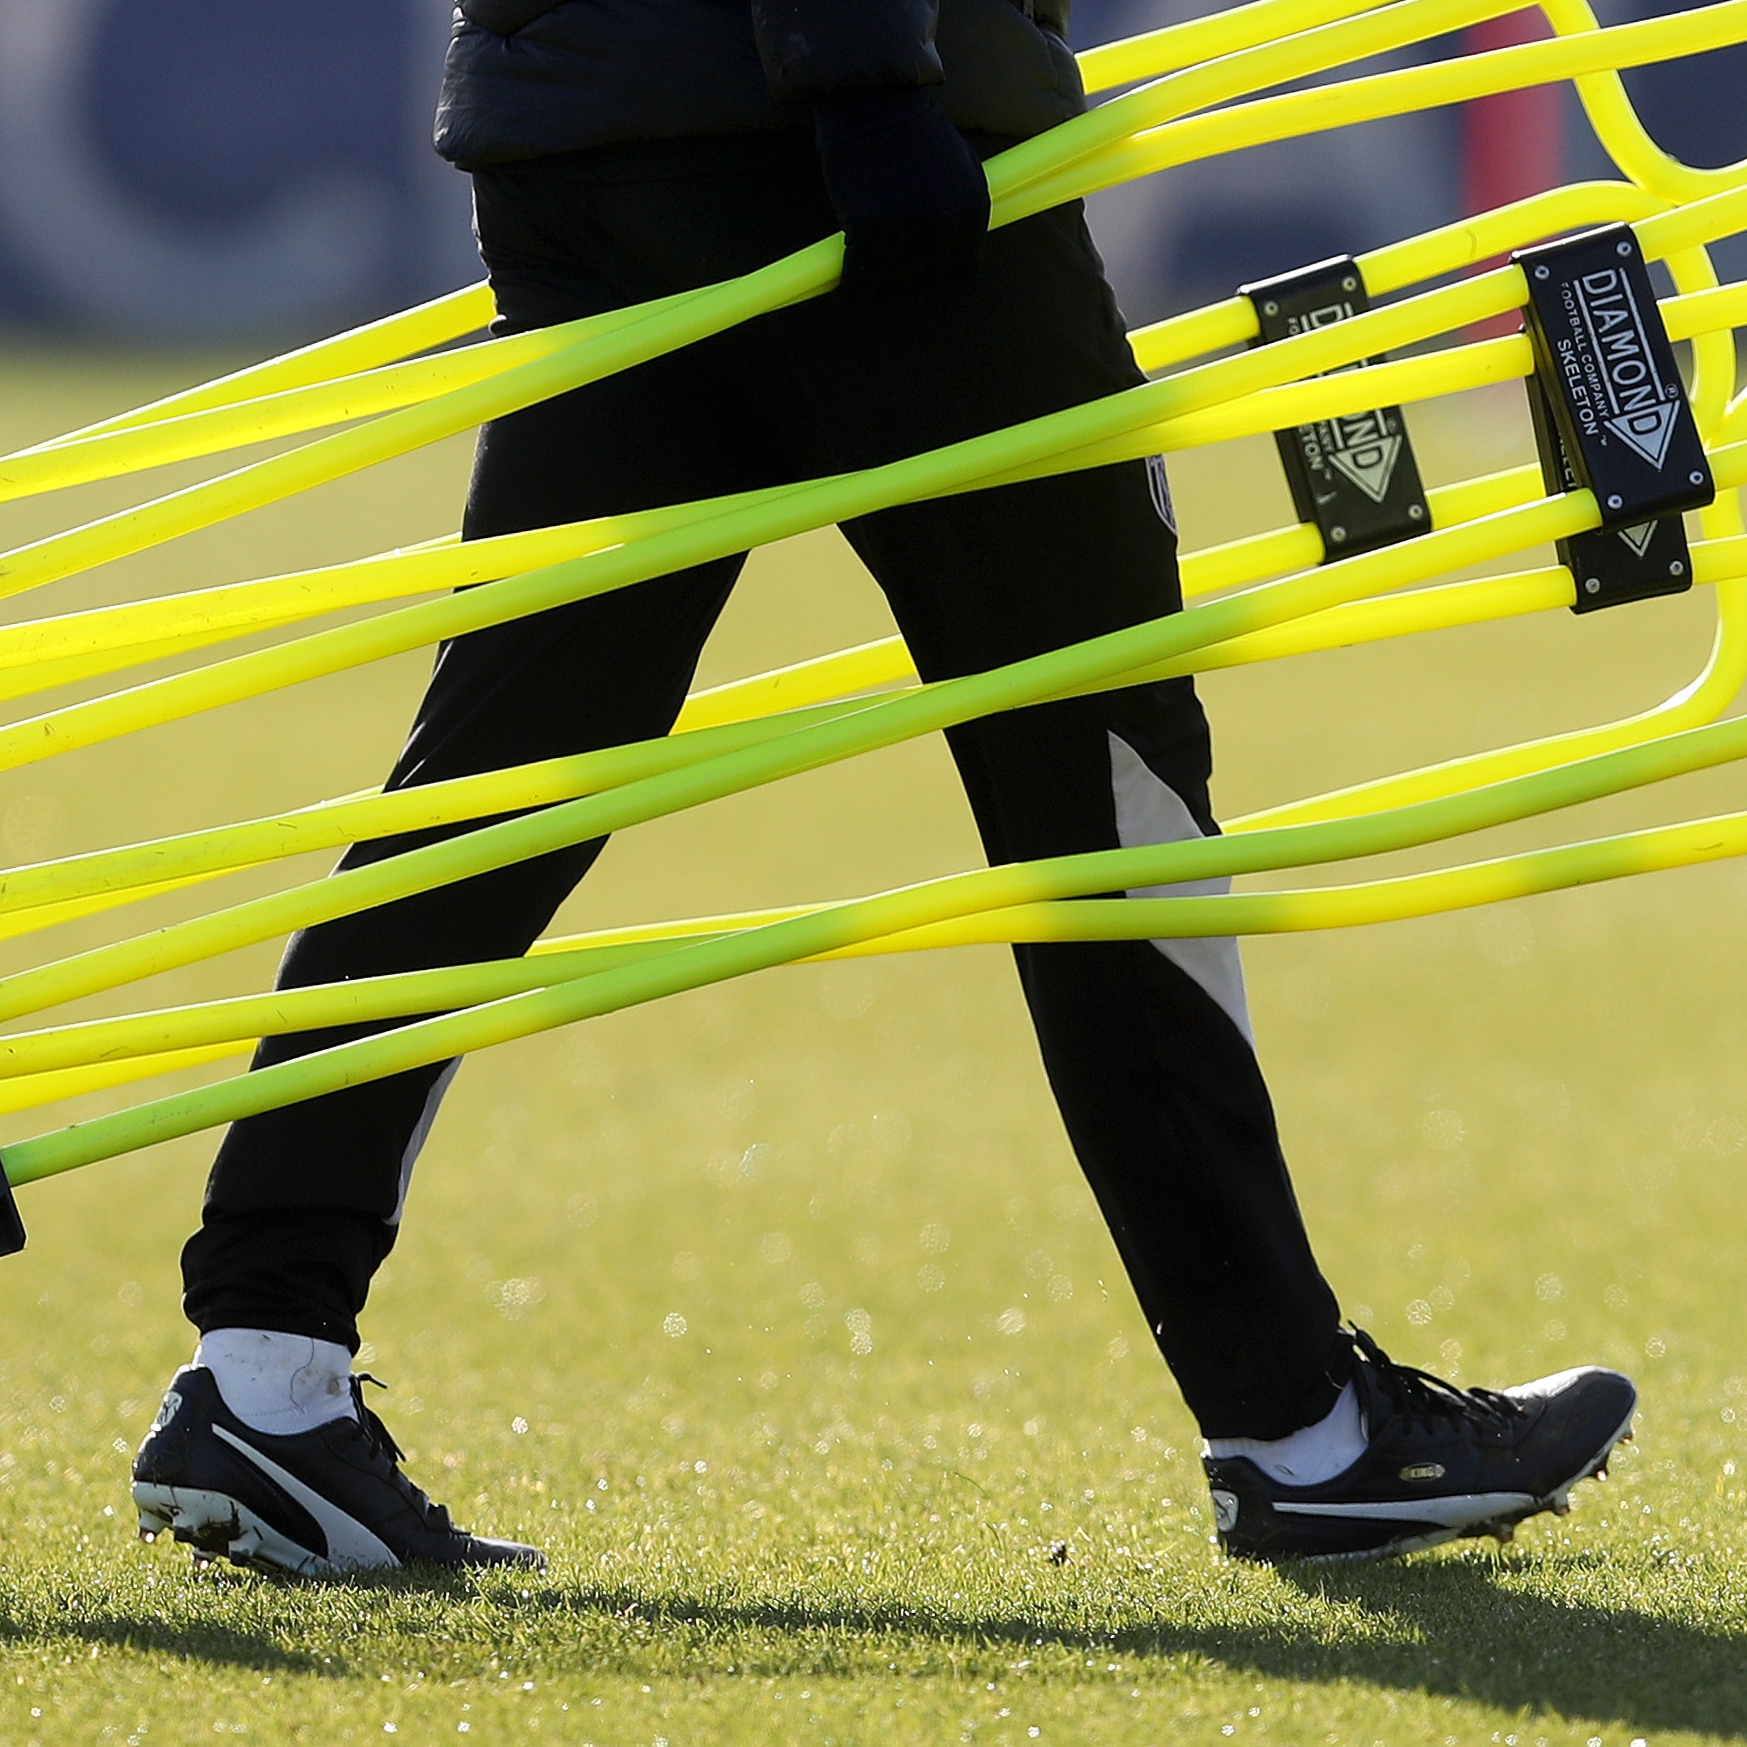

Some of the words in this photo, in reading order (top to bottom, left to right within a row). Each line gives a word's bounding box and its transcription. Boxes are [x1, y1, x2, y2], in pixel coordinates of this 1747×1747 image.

[1557, 338, 1599, 436] SKELETON
[1561, 282, 1587, 351] FOOTBALL
[1581, 354, 1610, 418] COMPANY
[1582, 268, 1662, 435] DIAMOND
